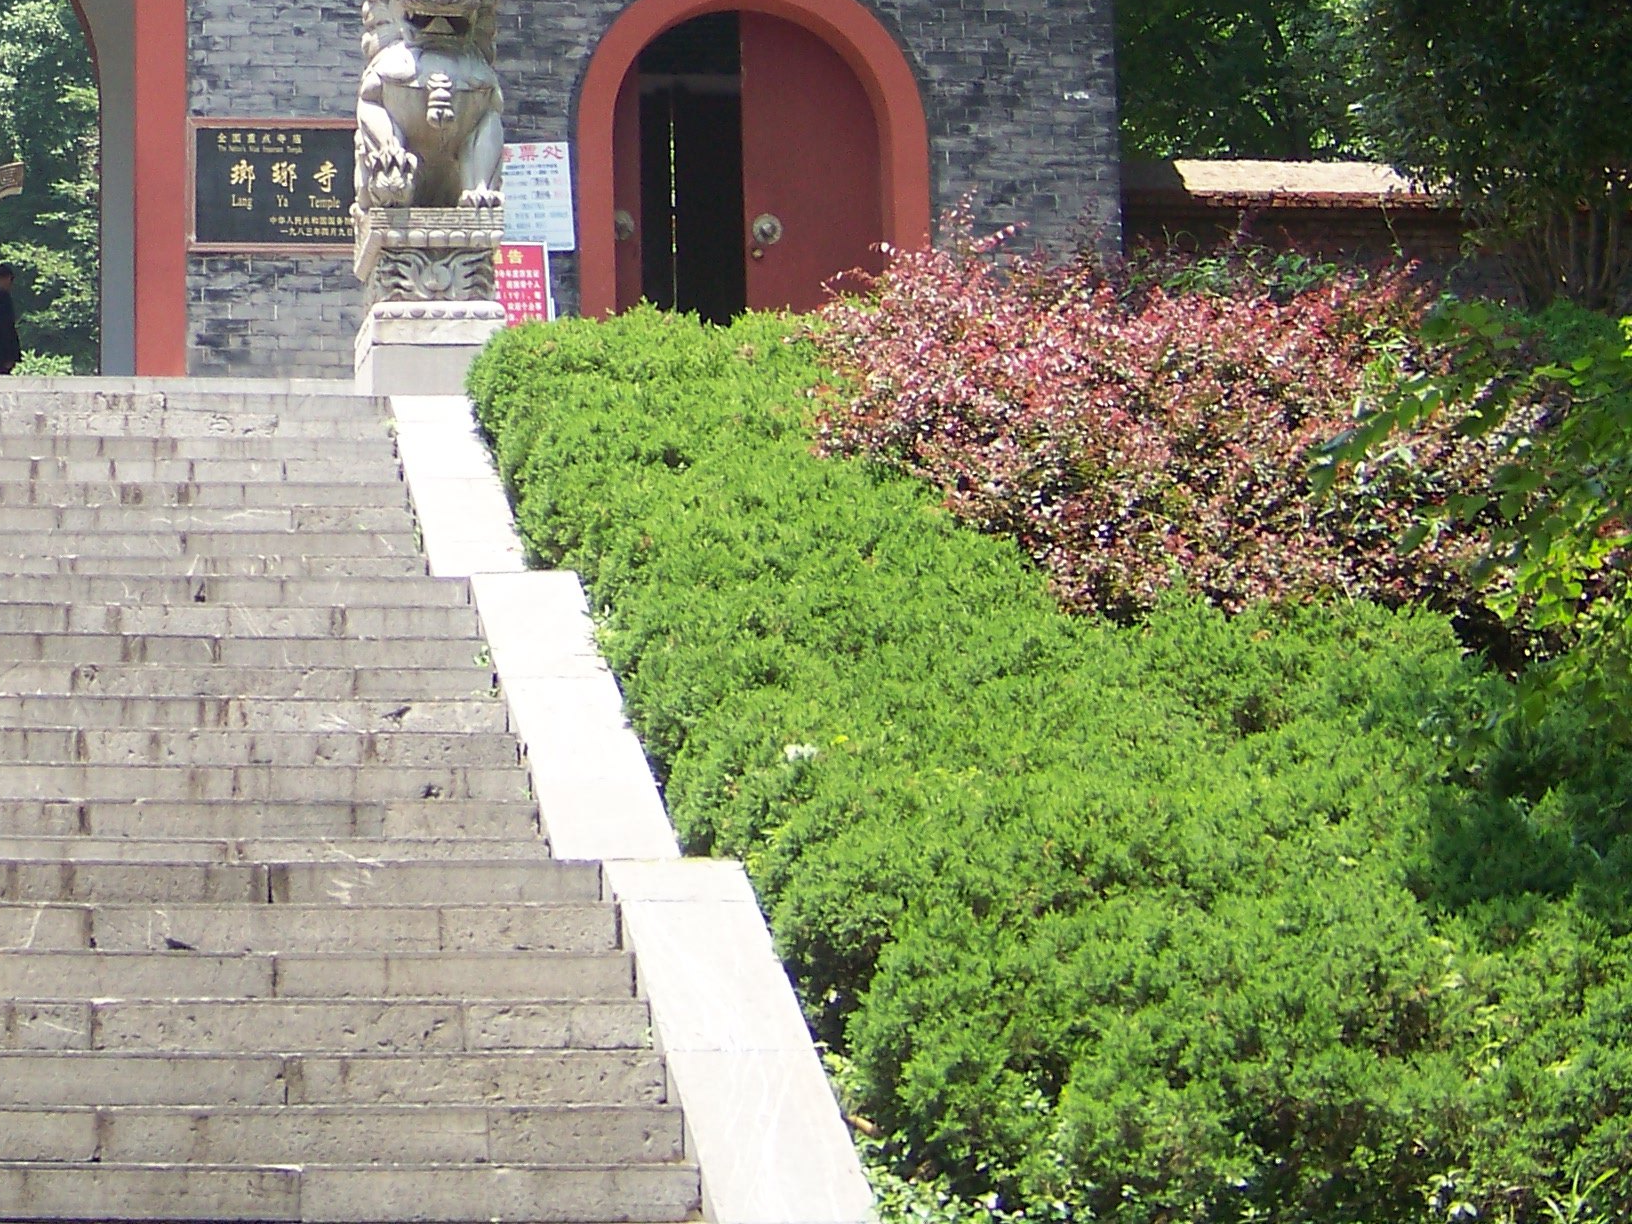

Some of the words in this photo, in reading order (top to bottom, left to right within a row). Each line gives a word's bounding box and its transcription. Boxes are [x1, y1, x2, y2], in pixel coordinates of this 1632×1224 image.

[231, 194, 254, 210] Lang
[276, 194, 289, 208] Ya
[308, 195, 341, 210] Temple
